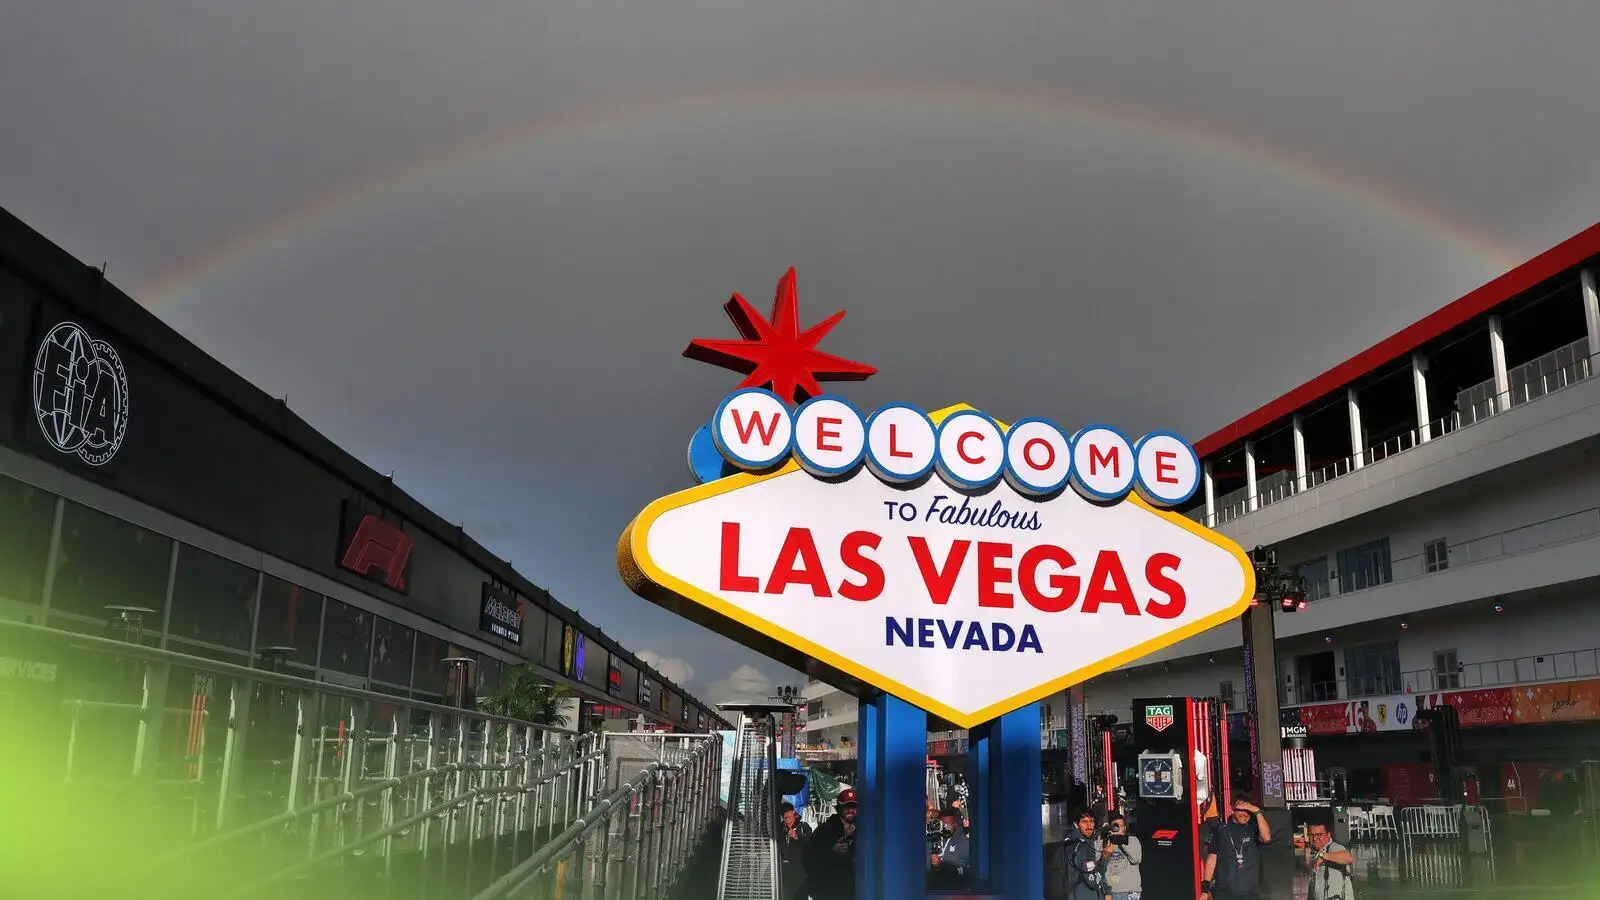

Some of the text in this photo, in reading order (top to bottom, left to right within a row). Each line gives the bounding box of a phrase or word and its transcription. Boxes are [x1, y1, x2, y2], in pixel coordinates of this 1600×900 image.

[37, 336, 117, 447] FIA
[731, 408, 1179, 484] WELCOME
[884, 496, 1042, 531] TO Fabulous
[720, 522, 1186, 619] LAS VEGAS
[886, 617, 1042, 653] NEVADA
[1147, 717, 1171, 729] HEUER
[1148, 707, 1170, 716] TAG
[1345, 702, 1364, 728] 16
[1396, 702, 1408, 724] hp
[1286, 726, 1307, 734] MGM
[1272, 775, 1282, 798] LAS
